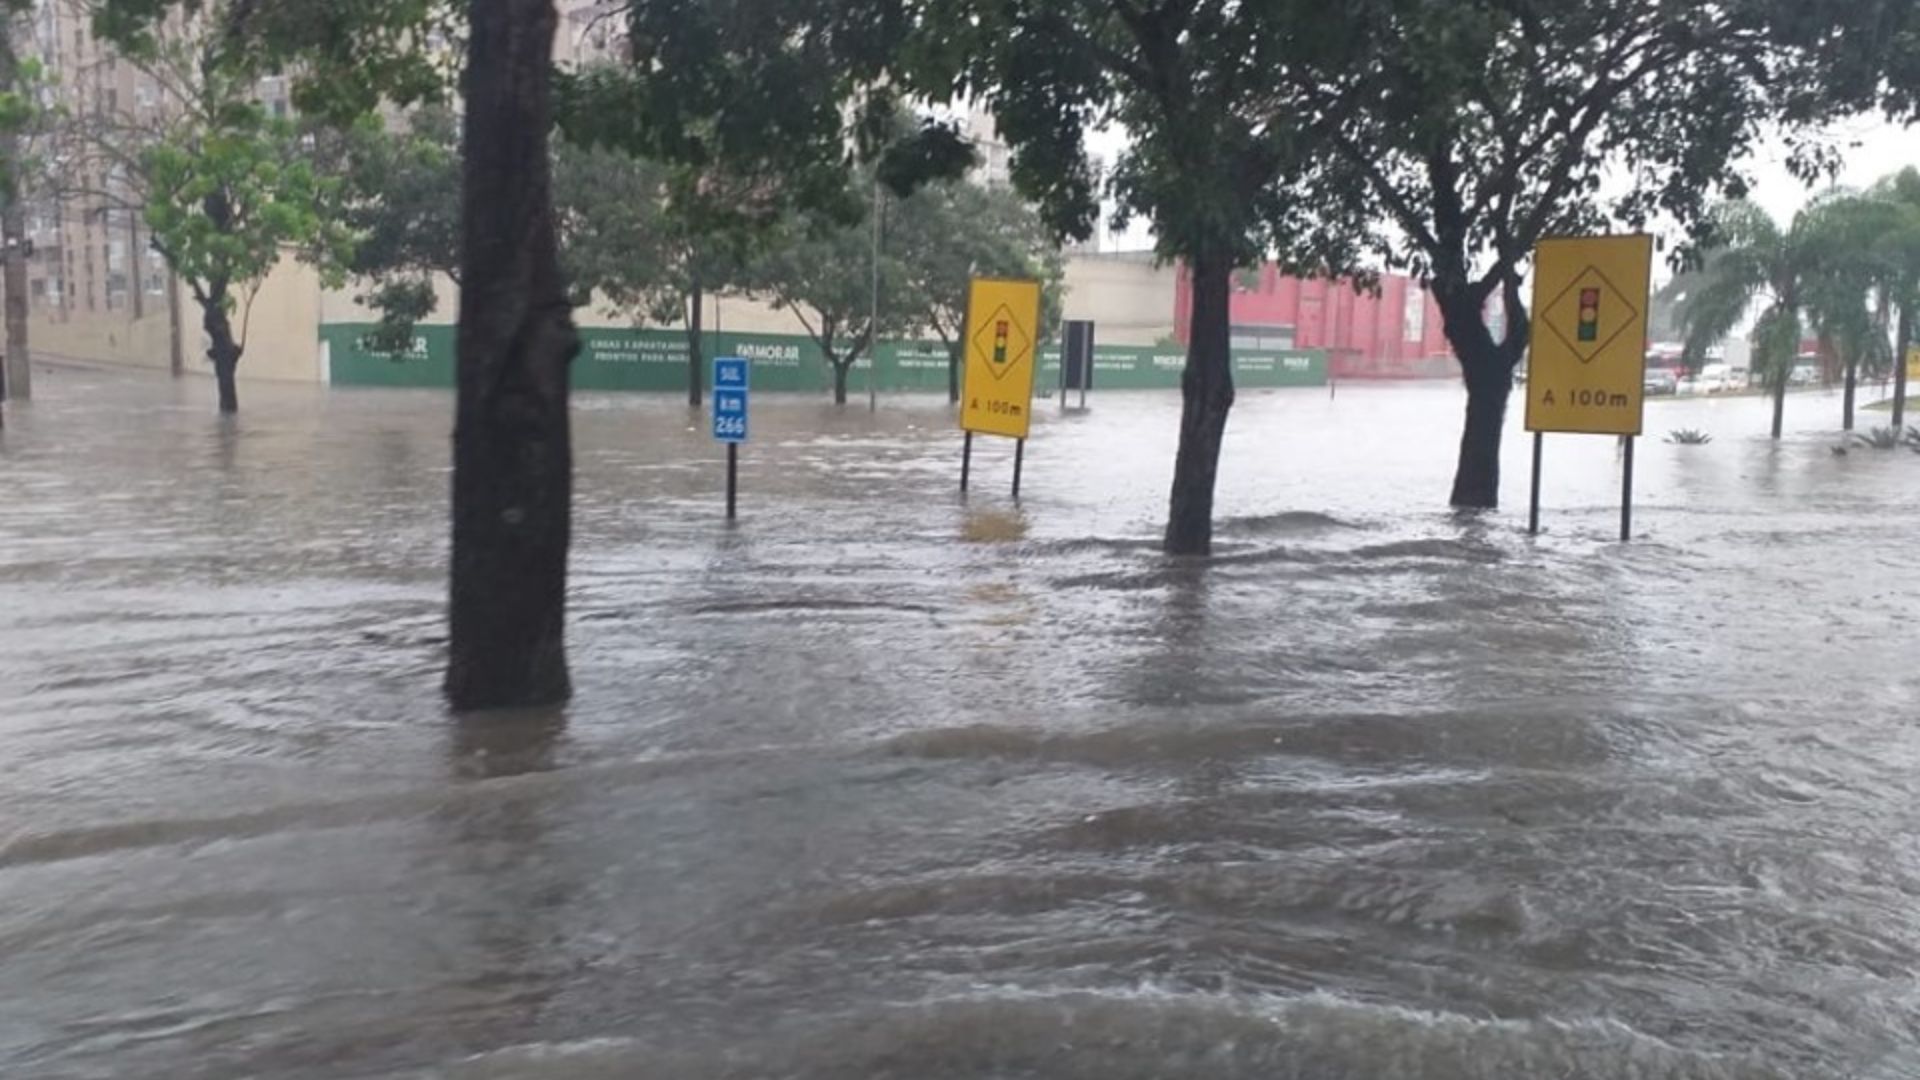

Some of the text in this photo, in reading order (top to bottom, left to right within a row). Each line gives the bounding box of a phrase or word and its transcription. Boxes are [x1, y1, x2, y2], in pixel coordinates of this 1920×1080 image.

[721, 367, 741, 380] SUL
[720, 397, 741, 411] km
[969, 397, 1022, 416] A 100m
[1543, 389, 1628, 407] A 100m
[717, 416, 744, 434] 266
